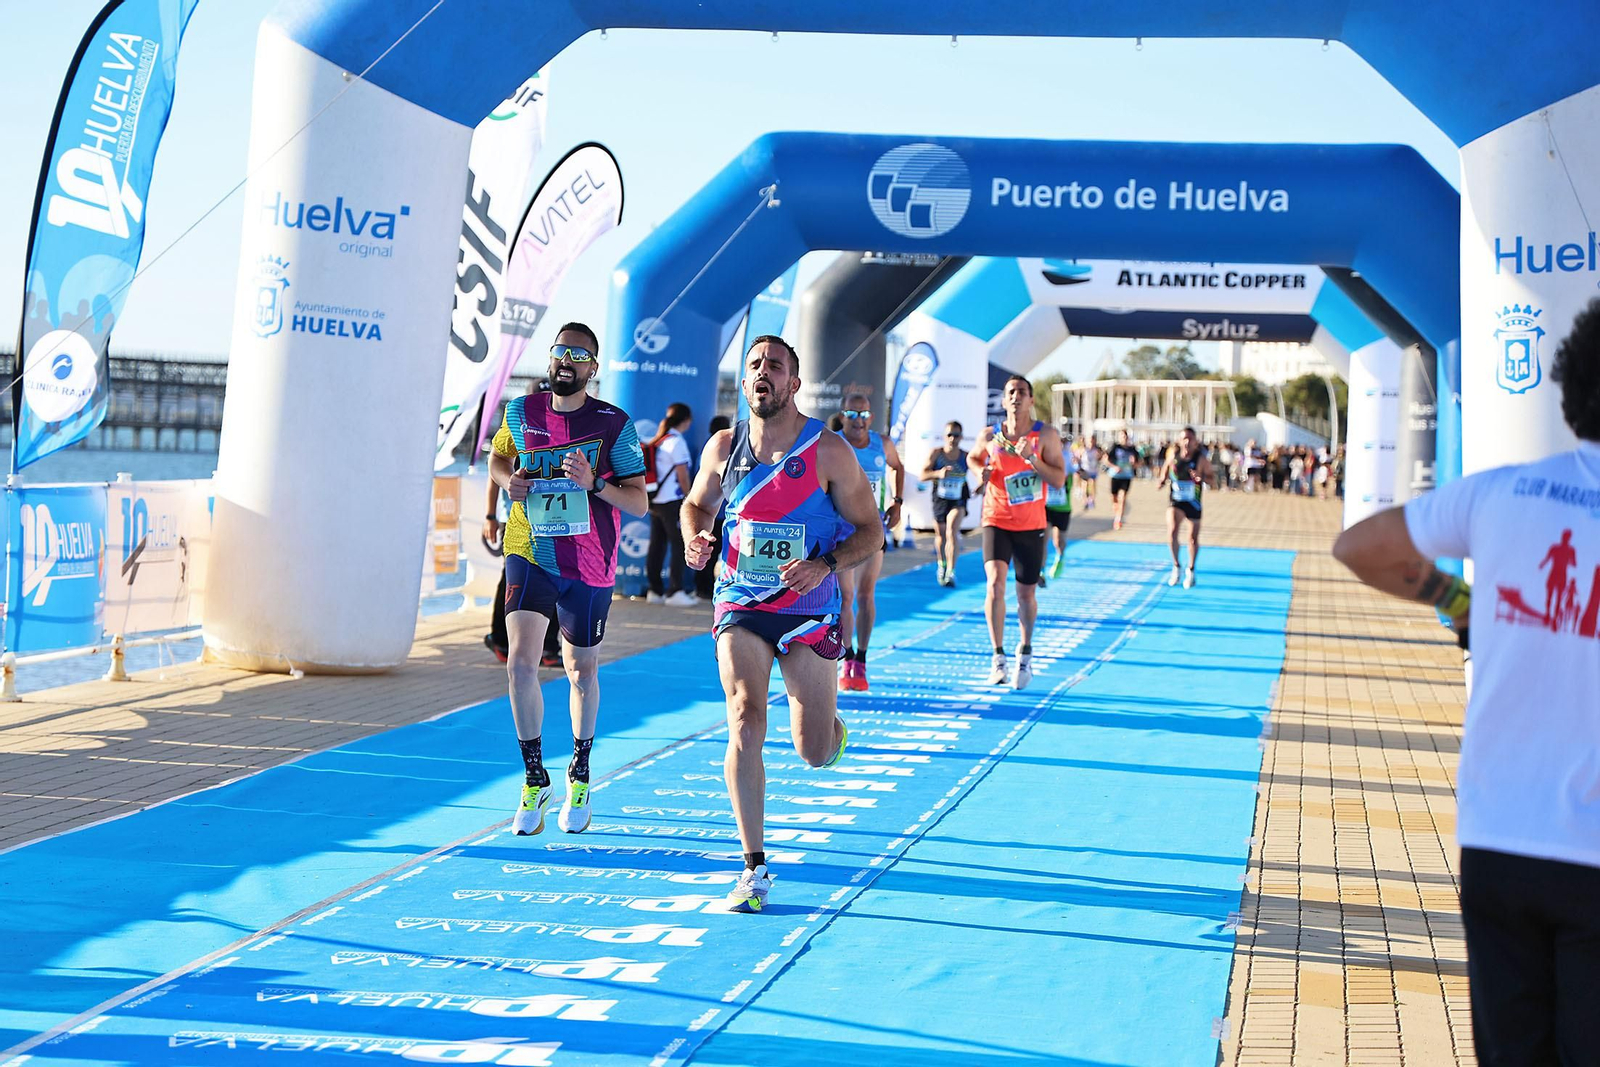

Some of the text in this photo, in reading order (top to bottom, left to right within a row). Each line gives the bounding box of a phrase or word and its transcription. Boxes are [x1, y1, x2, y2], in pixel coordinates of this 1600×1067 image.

[80, 33, 142, 158] HUELVA
[506, 86, 543, 108] IF
[991, 177, 1289, 212] Puerto de Huelva
[260, 192, 397, 240] Huelva
[520, 170, 605, 269] AVATEL
[339, 242, 393, 258] original
[1495, 232, 1600, 274] Huel
[449, 167, 507, 363] CSIF
[1117, 269, 1306, 290] ATLANTIC COPPER
[294, 301, 386, 320] Ayuntamiento de
[292, 315, 382, 341] HUELVA
[1182, 318, 1260, 340] Syrluz
[641, 361, 657, 373] de
[659, 362, 698, 377] Huelva
[1012, 475, 1037, 488] 107
[1513, 477, 1547, 497] CLUB
[541, 493, 567, 511] 71
[57, 522, 94, 560] HUELVA
[747, 538, 791, 560] 148
[452, 890, 636, 907] HUELVA
[395, 918, 592, 936] HUELVA
[330, 955, 538, 973] HUELVA
[257, 992, 482, 1011] HUELVA
[169, 1036, 412, 1055] HUELVA
